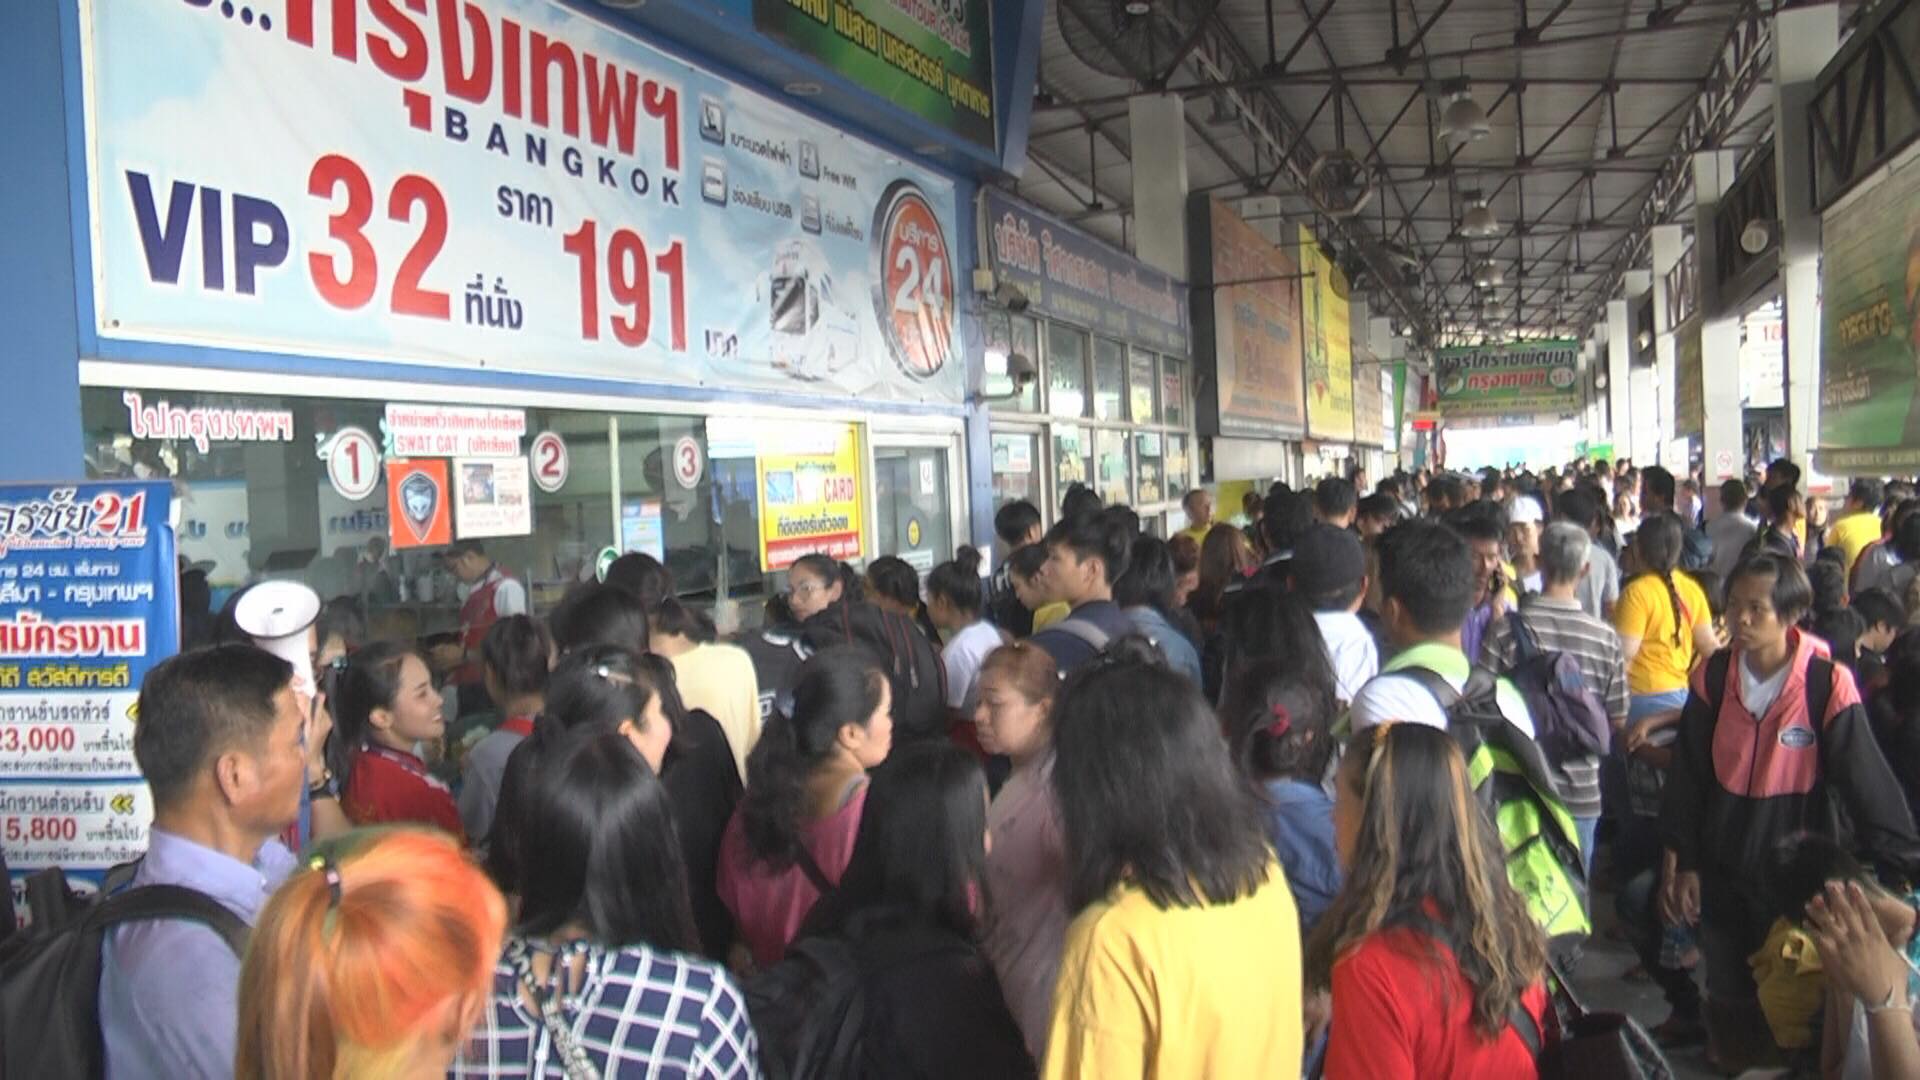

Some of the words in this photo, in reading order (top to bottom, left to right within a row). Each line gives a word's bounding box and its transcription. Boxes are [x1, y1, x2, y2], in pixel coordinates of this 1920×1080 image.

[445, 107, 680, 206] BANGKOK
[497, 184, 554, 228] ราคา
[125, 169, 289, 296] VIP
[307, 154, 450, 322] 32
[563, 219, 687, 353] 191
[895, 246, 946, 321] 24
[465, 275, 523, 330] ที่นั่ง
[1467, 369, 1546, 395] กรุงเทพฯ
[124, 391, 294, 454] ไปกรุงเทพฯ
[397, 434, 432, 453] SWAT
[436, 434, 458, 454] CAT
[540, 440, 562, 477] 2
[344, 441, 361, 485] 1
[681, 446, 698, 478] 3
[824, 477, 854, 503] CARD
[21, 562, 44, 577] 24
[64, 581, 154, 608] กรุงเทพฯ
[27, 664, 130, 688] สวัสดิการดี
[0, 726, 75, 757] 3,000
[0, 817, 77, 846] 5,800
